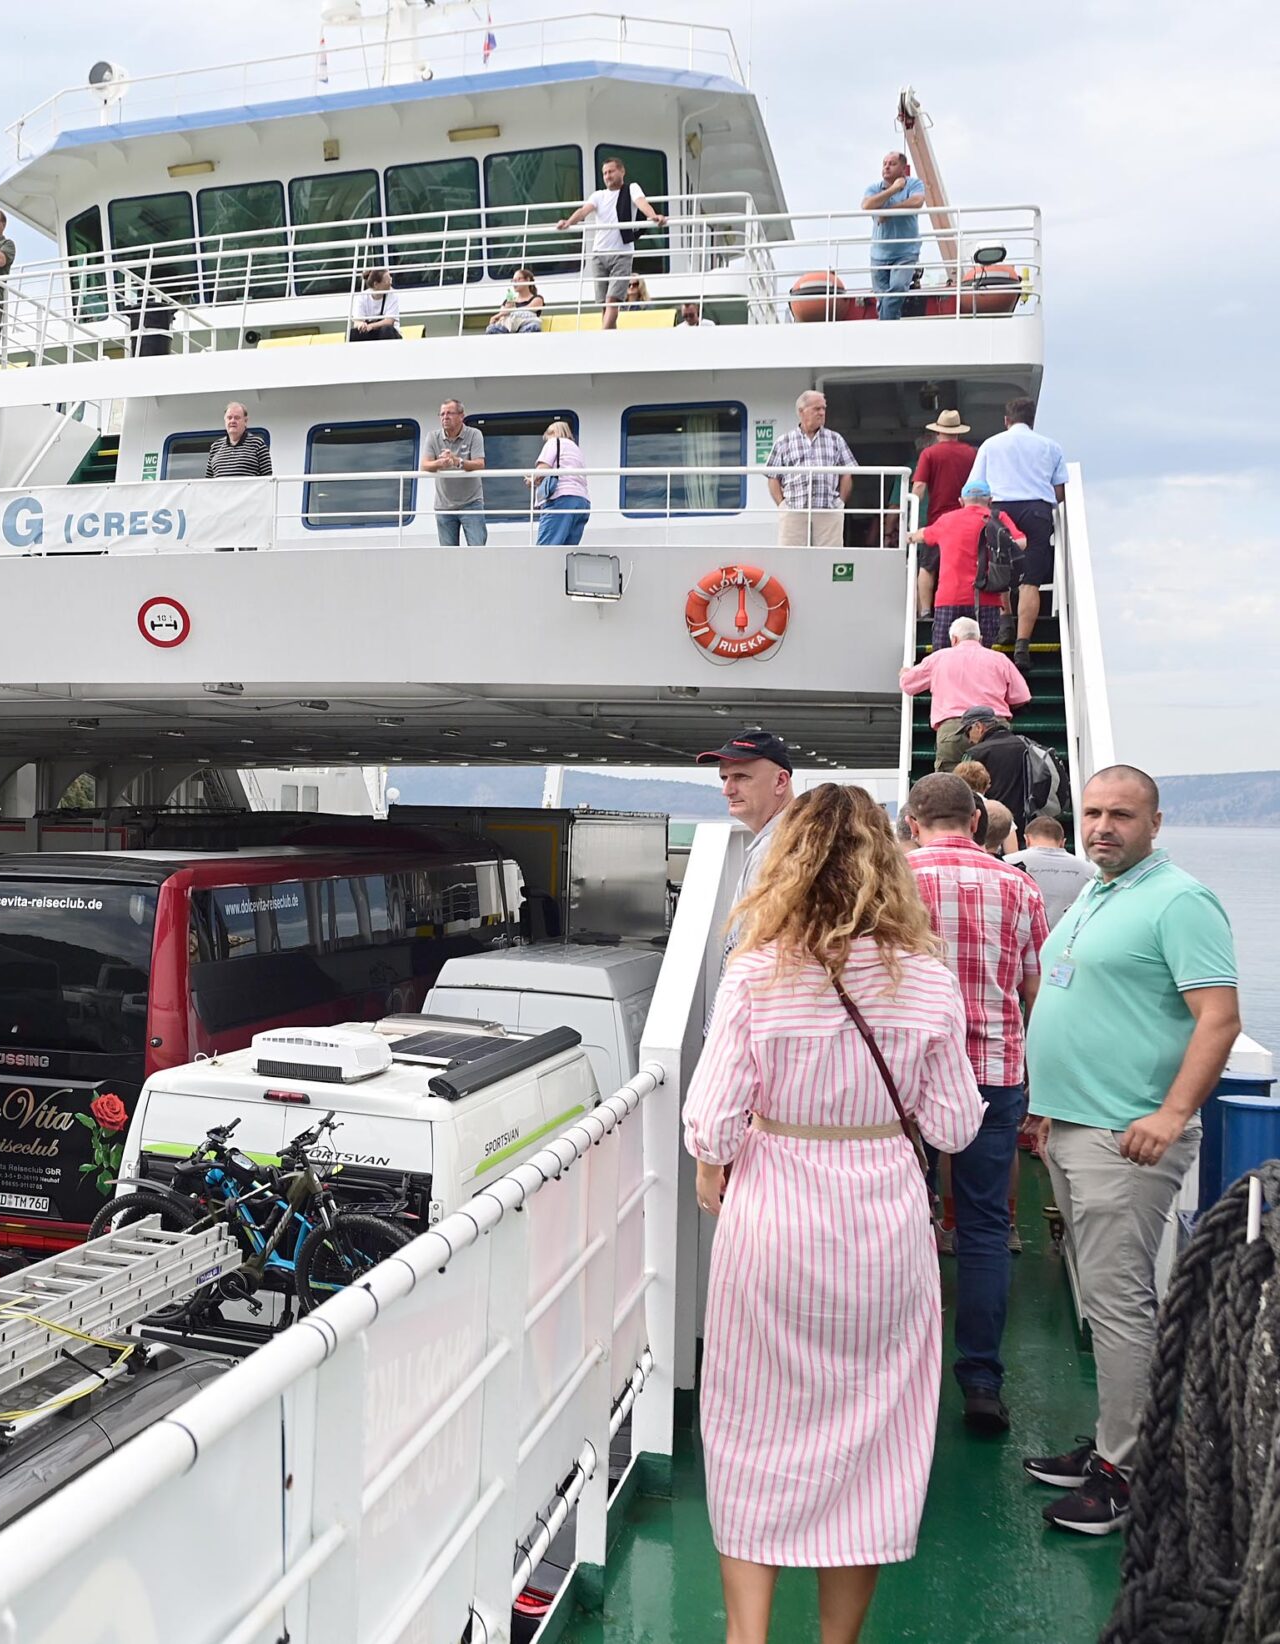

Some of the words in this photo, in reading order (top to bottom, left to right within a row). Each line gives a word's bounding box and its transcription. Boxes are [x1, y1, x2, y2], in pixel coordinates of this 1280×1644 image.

[756, 428, 772, 439] WC
[145, 455, 158, 465] WC
[64, 508, 188, 544] (CRES)
[708, 576, 754, 594] ILOVK
[719, 634, 766, 653] RIJEKA
[224, 894, 299, 916] www.dolcevita-reiseclub.de
[2, 1087, 74, 1131] Vita
[484, 1127, 521, 1158] SPORTSVAN
[306, 1146, 392, 1167] ORTSVAN
[8, 1163, 44, 1175] Reiseclub
[45, 1167, 62, 1177] GbR
[40, 1176, 61, 1184] Neuhof
[14, 1195, 28, 1208] TM
[29, 1196, 48, 1210] 760
